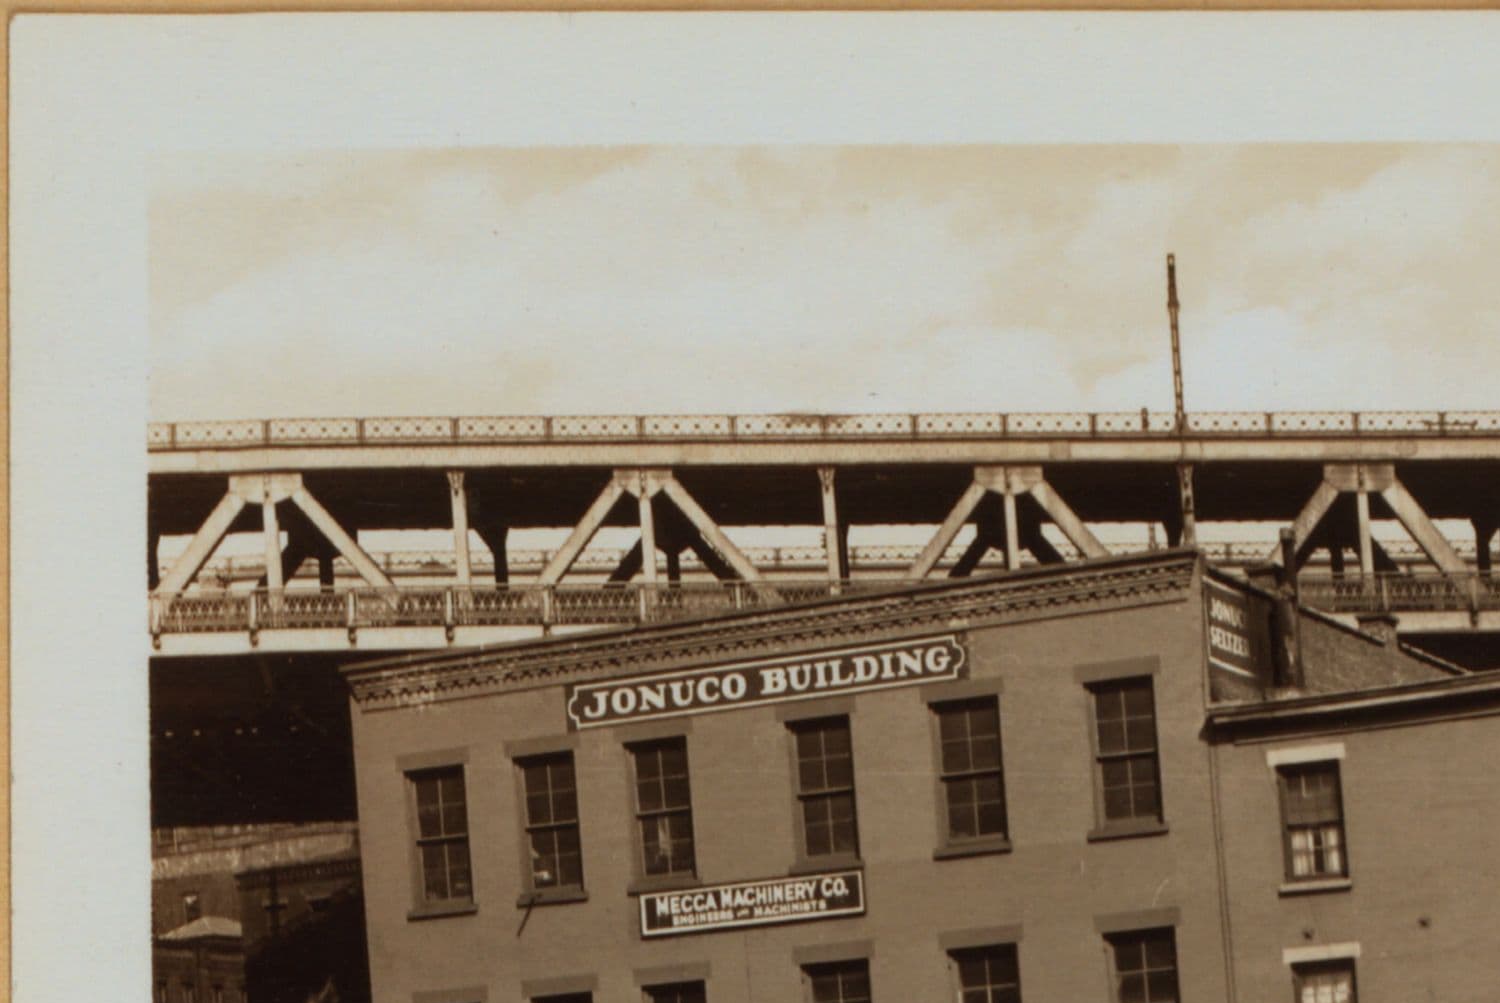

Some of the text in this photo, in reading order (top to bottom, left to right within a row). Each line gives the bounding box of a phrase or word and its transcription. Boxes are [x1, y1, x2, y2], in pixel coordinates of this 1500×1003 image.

[582, 645, 952, 720] JONUCO BUILDING
[655, 877, 850, 917] MECCA MACHINERY CO.
[753, 899, 828, 917] MACHINISTS
